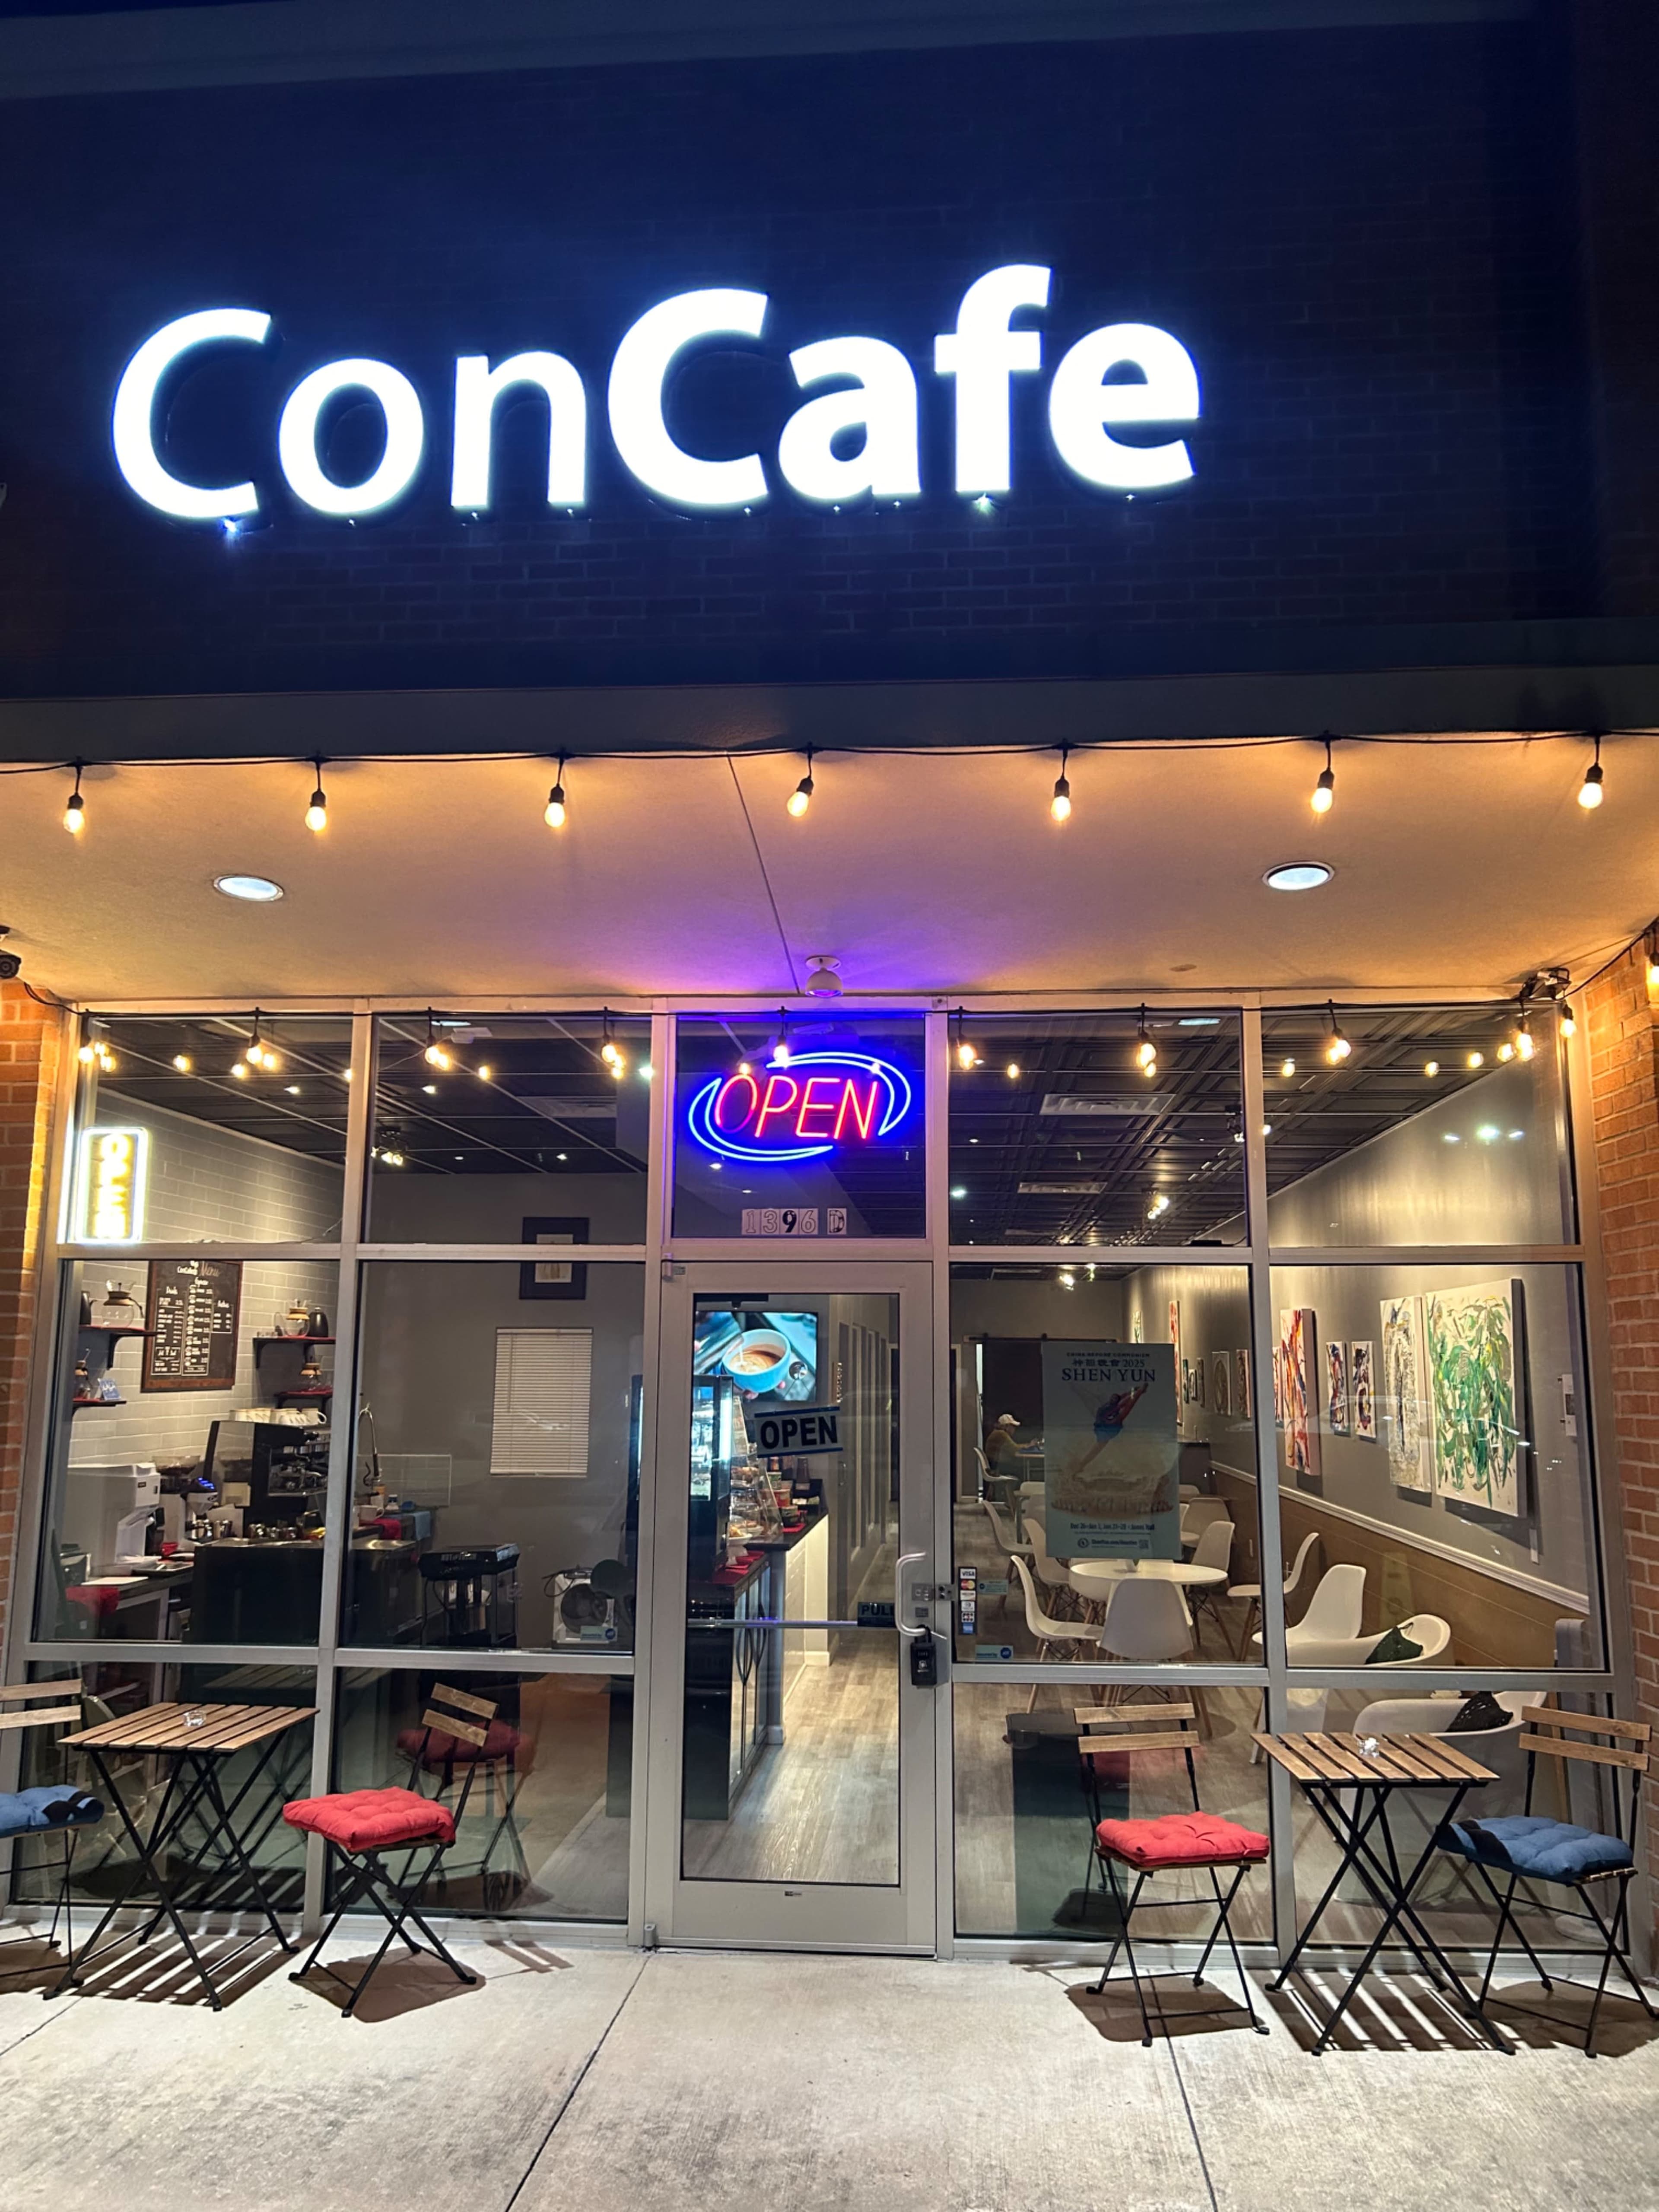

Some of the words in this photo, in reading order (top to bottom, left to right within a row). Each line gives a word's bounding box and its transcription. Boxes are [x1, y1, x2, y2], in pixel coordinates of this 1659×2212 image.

[113, 264, 1200, 518] ConCafe
[714, 1074, 878, 1139] OPEN
[92, 1133, 129, 1239] OPE
[746, 1210, 816, 1233] 1396
[829, 1210, 845, 1233] D
[1061, 1368, 1111, 1382] SHEN
[1117, 1368, 1156, 1382] YUN
[1123, 1359, 1145, 1368] 2025
[760, 1415, 838, 1449] OPEN
